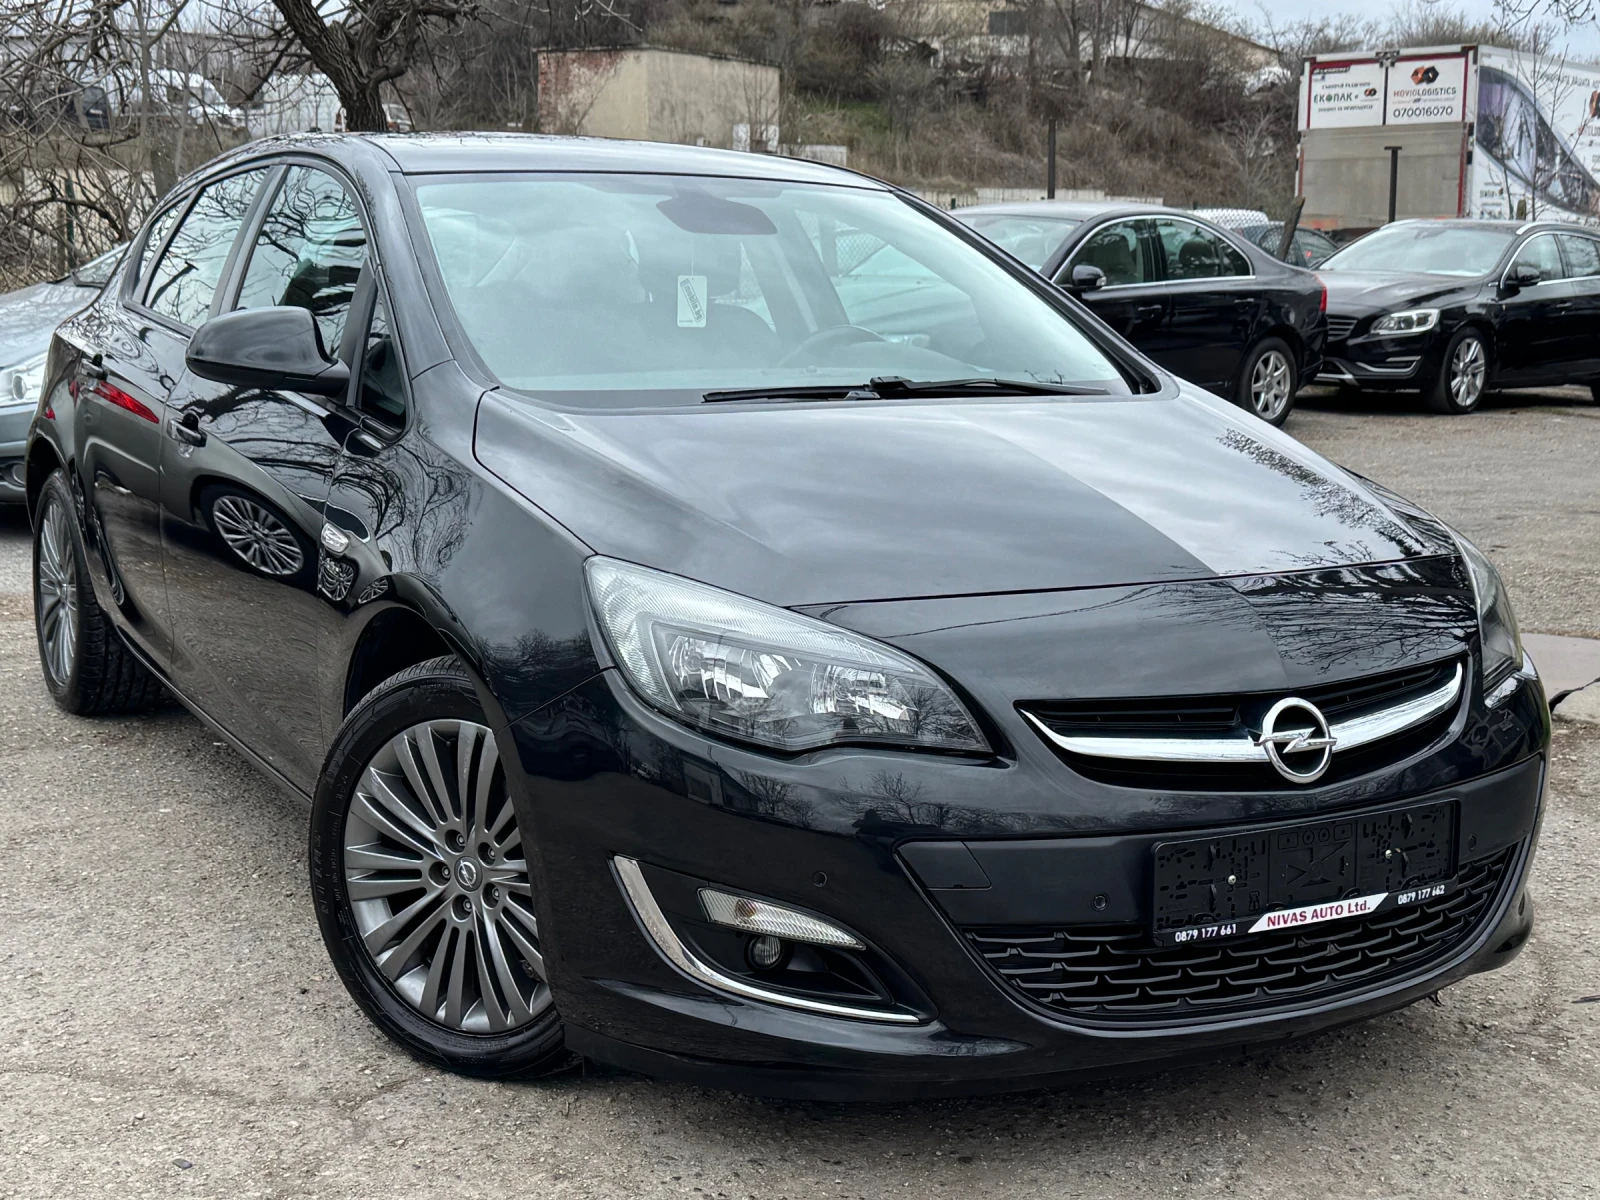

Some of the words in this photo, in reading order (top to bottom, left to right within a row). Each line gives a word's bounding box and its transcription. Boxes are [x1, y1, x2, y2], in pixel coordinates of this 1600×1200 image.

[1393, 87, 1456, 97] MOVIOLOGISTICS
[1393, 105, 1453, 118] 070016070
[1397, 891, 1416, 905] 0879
[1418, 888, 1431, 900] 177
[1432, 884, 1445, 896] 662
[1267, 910, 1307, 927] NIVAS
[1310, 904, 1344, 920] AUTO
[1347, 899, 1370, 914] Ltd.
[1175, 929, 1199, 942] 0879
[1201, 926, 1218, 938] 177
[1220, 923, 1236, 936] 661
